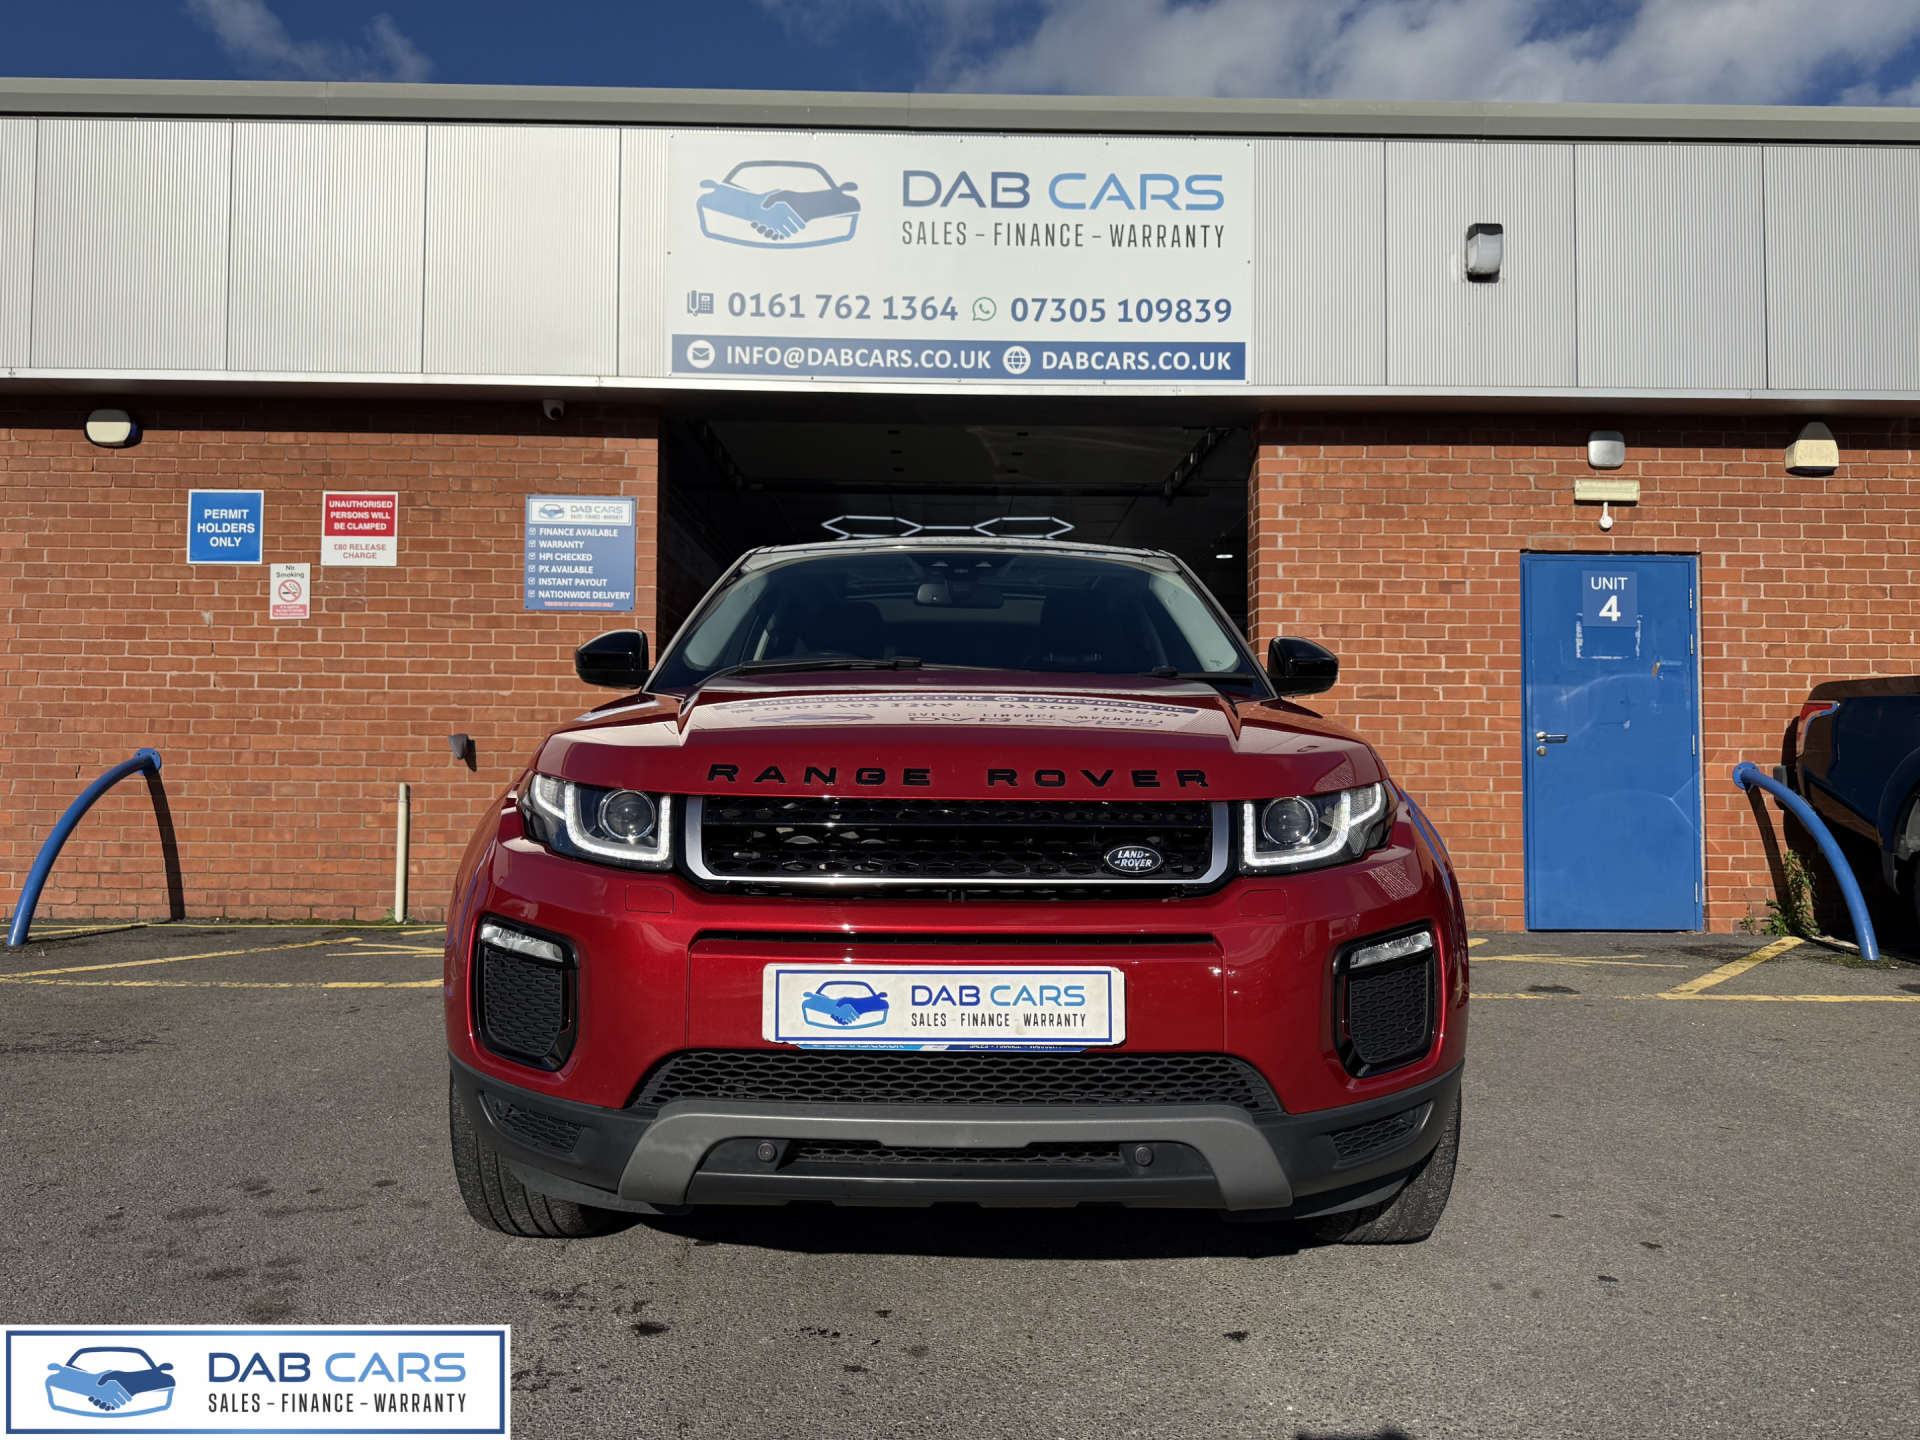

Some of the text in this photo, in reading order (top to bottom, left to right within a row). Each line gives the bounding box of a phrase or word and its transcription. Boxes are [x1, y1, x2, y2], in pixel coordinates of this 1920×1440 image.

[902, 170, 1225, 211] DAB CARS
[902, 221, 967, 245] SALES
[993, 222, 1085, 248] FINANCE
[1109, 224, 1225, 249] WARRANTY
[727, 291, 1233, 324] 0161 762 1364 07305 109839
[726, 345, 1232, 371] INFO@DABCARS.CO.UK DABCARS.CO.UK
[328, 500, 393, 509] UNAUTHORISED
[570, 505, 624, 515] DAB CARS
[203, 508, 250, 520] PERMIT
[330, 511, 391, 520] PERSONS WILL
[196, 522, 256, 534] HOLDERS
[333, 522, 387, 531] BE CLAMPED
[539, 527, 619, 538] FINANCE AVAILABLE
[209, 536, 242, 548] ONLY
[349, 543, 387, 551] RELEASE
[539, 540, 585, 550] WARRANTY
[342, 552, 377, 560] CHARGE
[539, 552, 593, 562] HPI CHECKED
[275, 571, 305, 579] Smoking
[539, 565, 594, 575] PX AVAILABLE
[539, 577, 608, 588] INSTANT PAYOUT
[1590, 576, 1629, 591] UNIT
[538, 589, 631, 601] NATIONWIDE DELIVERY
[1598, 594, 1622, 623] 4
[706, 763, 1209, 788] RANGE ROVER
[911, 984, 1086, 1007] DAB CARS
[911, 1012, 1086, 1028] SALES FINANCE WARRANTY
